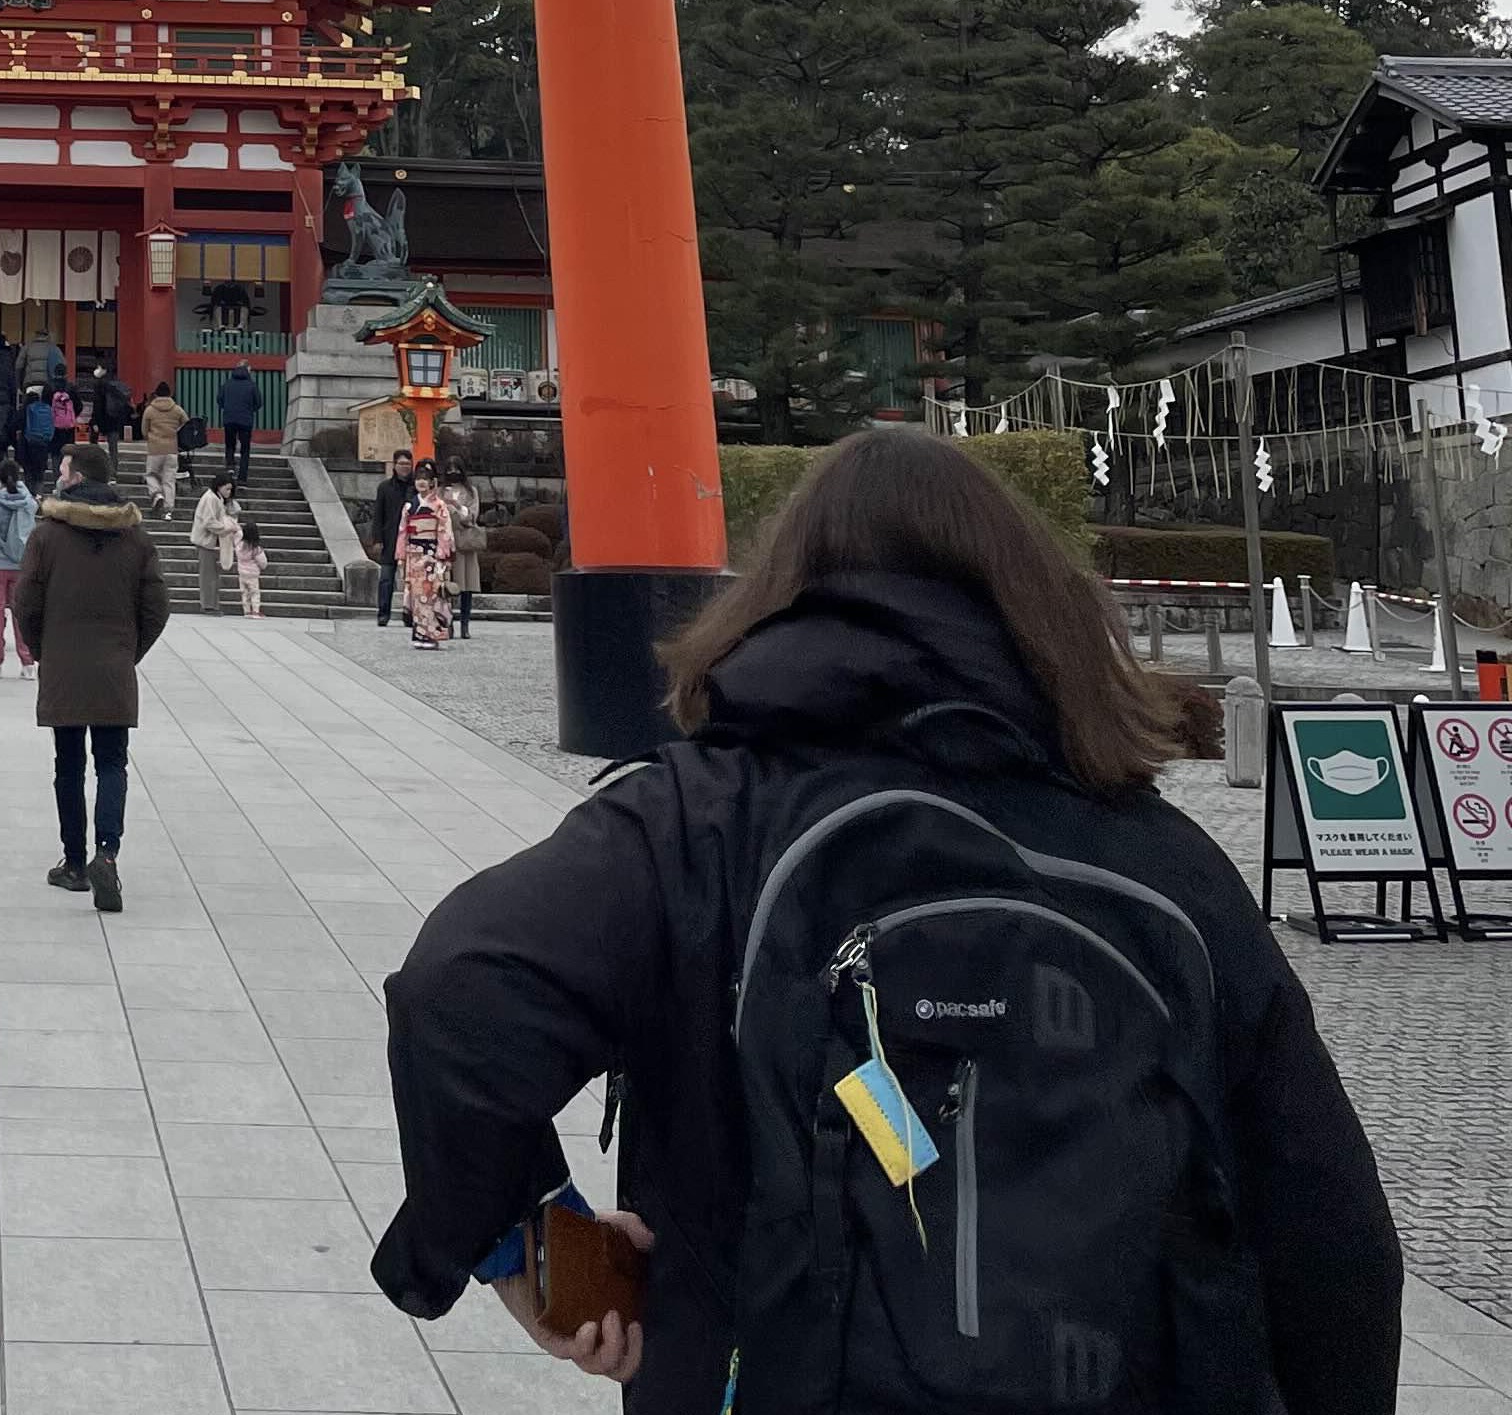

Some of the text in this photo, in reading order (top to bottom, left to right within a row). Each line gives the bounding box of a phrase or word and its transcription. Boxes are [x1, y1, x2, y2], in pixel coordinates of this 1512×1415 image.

[1316, 832, 1412, 842] マスクを着用してください
[1319, 848, 1415, 857] PLEASE WEAR A MASK
[935, 998, 1007, 1019] pacsafe
